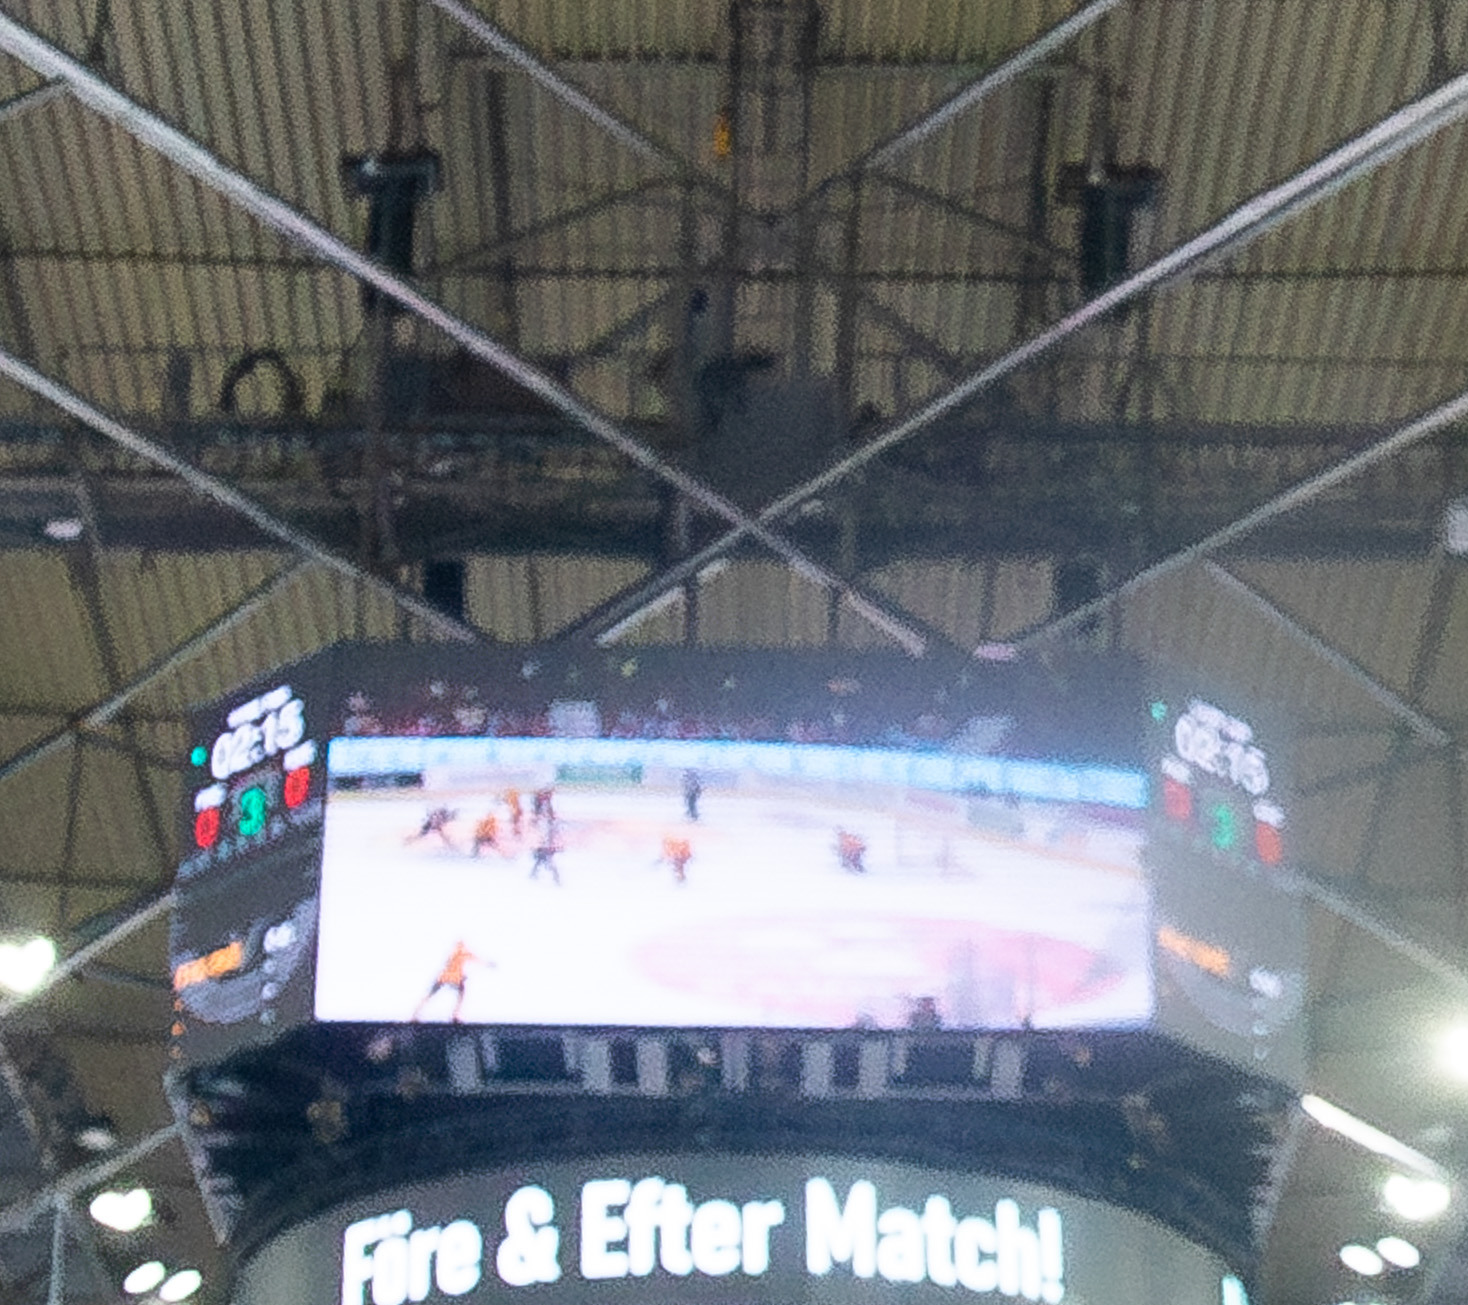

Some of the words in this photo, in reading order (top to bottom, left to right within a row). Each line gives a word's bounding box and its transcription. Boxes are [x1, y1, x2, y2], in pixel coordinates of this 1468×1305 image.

[497, 1185, 561, 1286] &
[580, 1176, 785, 1280] Efter
[804, 1176, 1066, 1305] Match!
